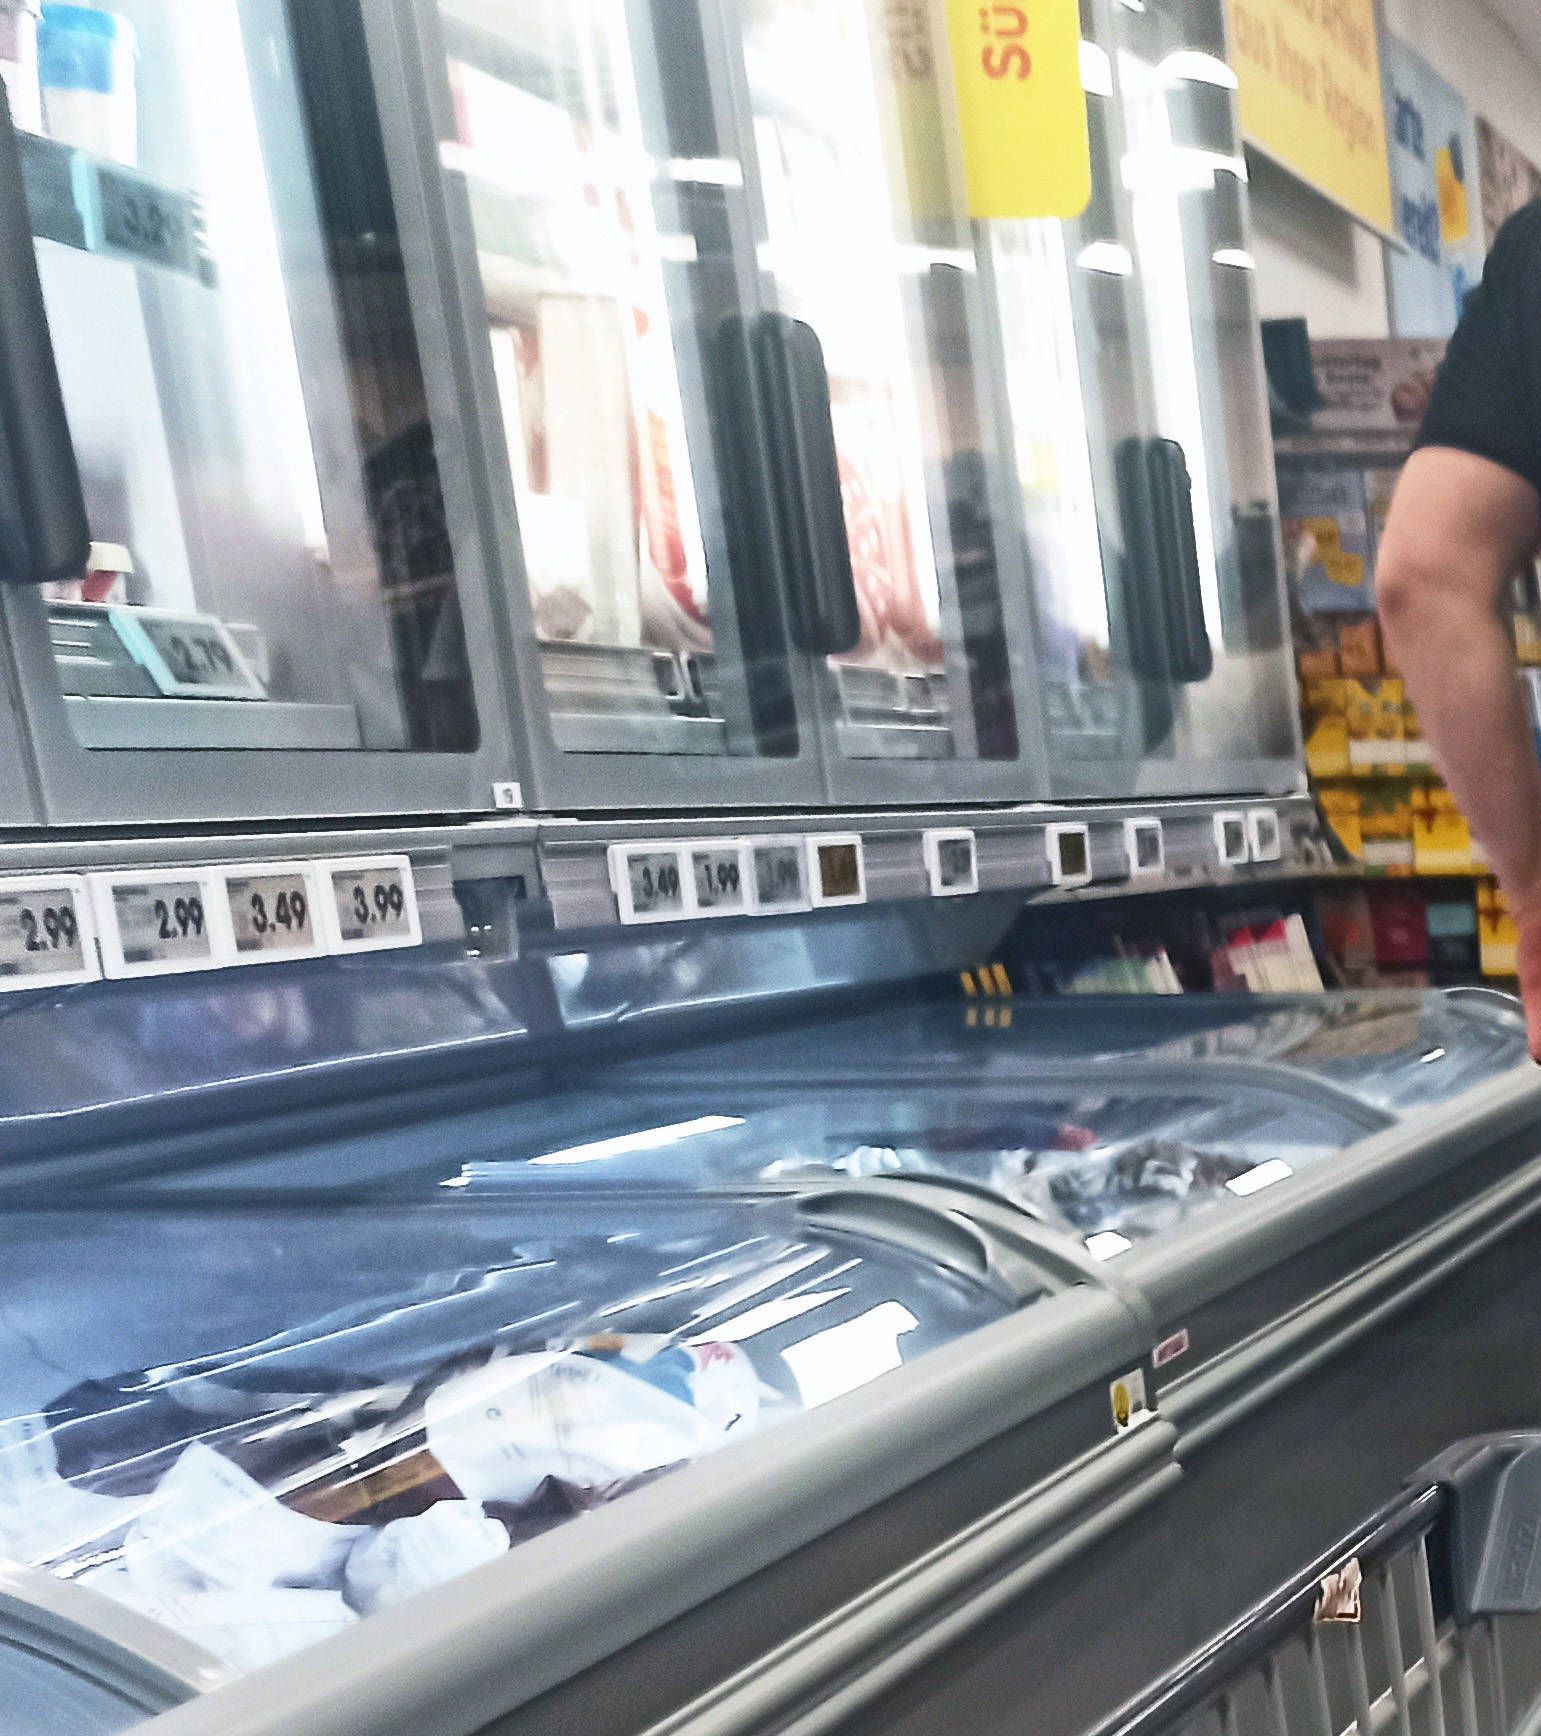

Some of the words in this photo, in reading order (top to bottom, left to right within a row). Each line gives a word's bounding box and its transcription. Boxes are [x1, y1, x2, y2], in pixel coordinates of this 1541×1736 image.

[154, 896, 205, 941] 2.99
[250, 890, 308, 935] 3.49
[352, 882, 405, 922] 3.99
[20, 905, 77, 953] 2.99
